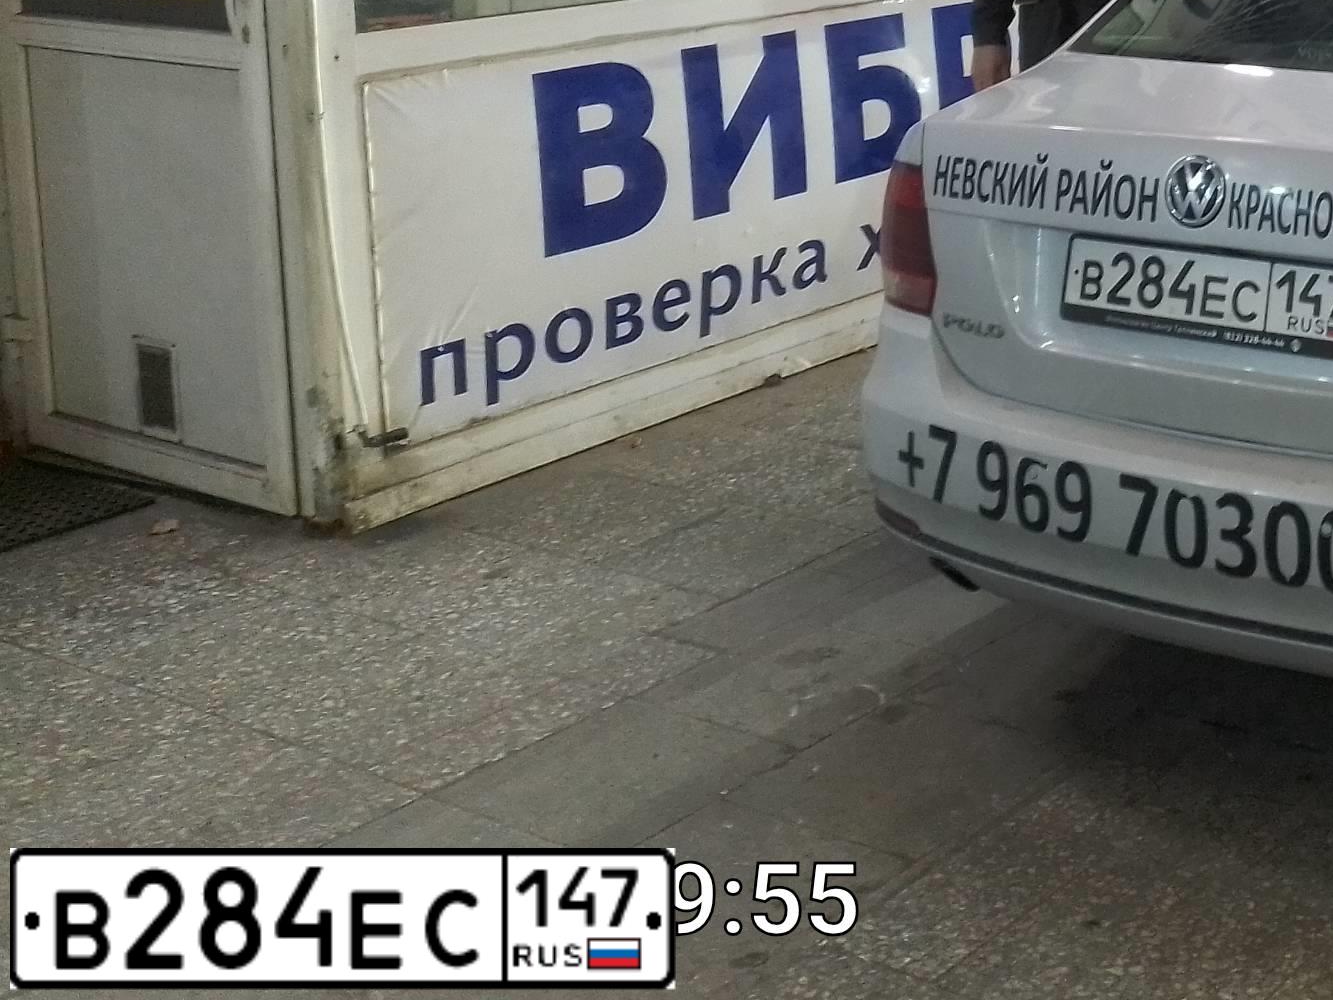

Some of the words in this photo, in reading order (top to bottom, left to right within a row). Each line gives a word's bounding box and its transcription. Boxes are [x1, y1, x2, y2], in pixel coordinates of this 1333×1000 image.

[933, 153, 1050, 210] НЕВСКИЙ
[1056, 159, 1160, 223] РАЙОН
[419, 237, 828, 407] проверка
[1286, 315, 1326, 336] RUS
[898, 424, 958, 504] +7
[976, 440, 1092, 543] 969
